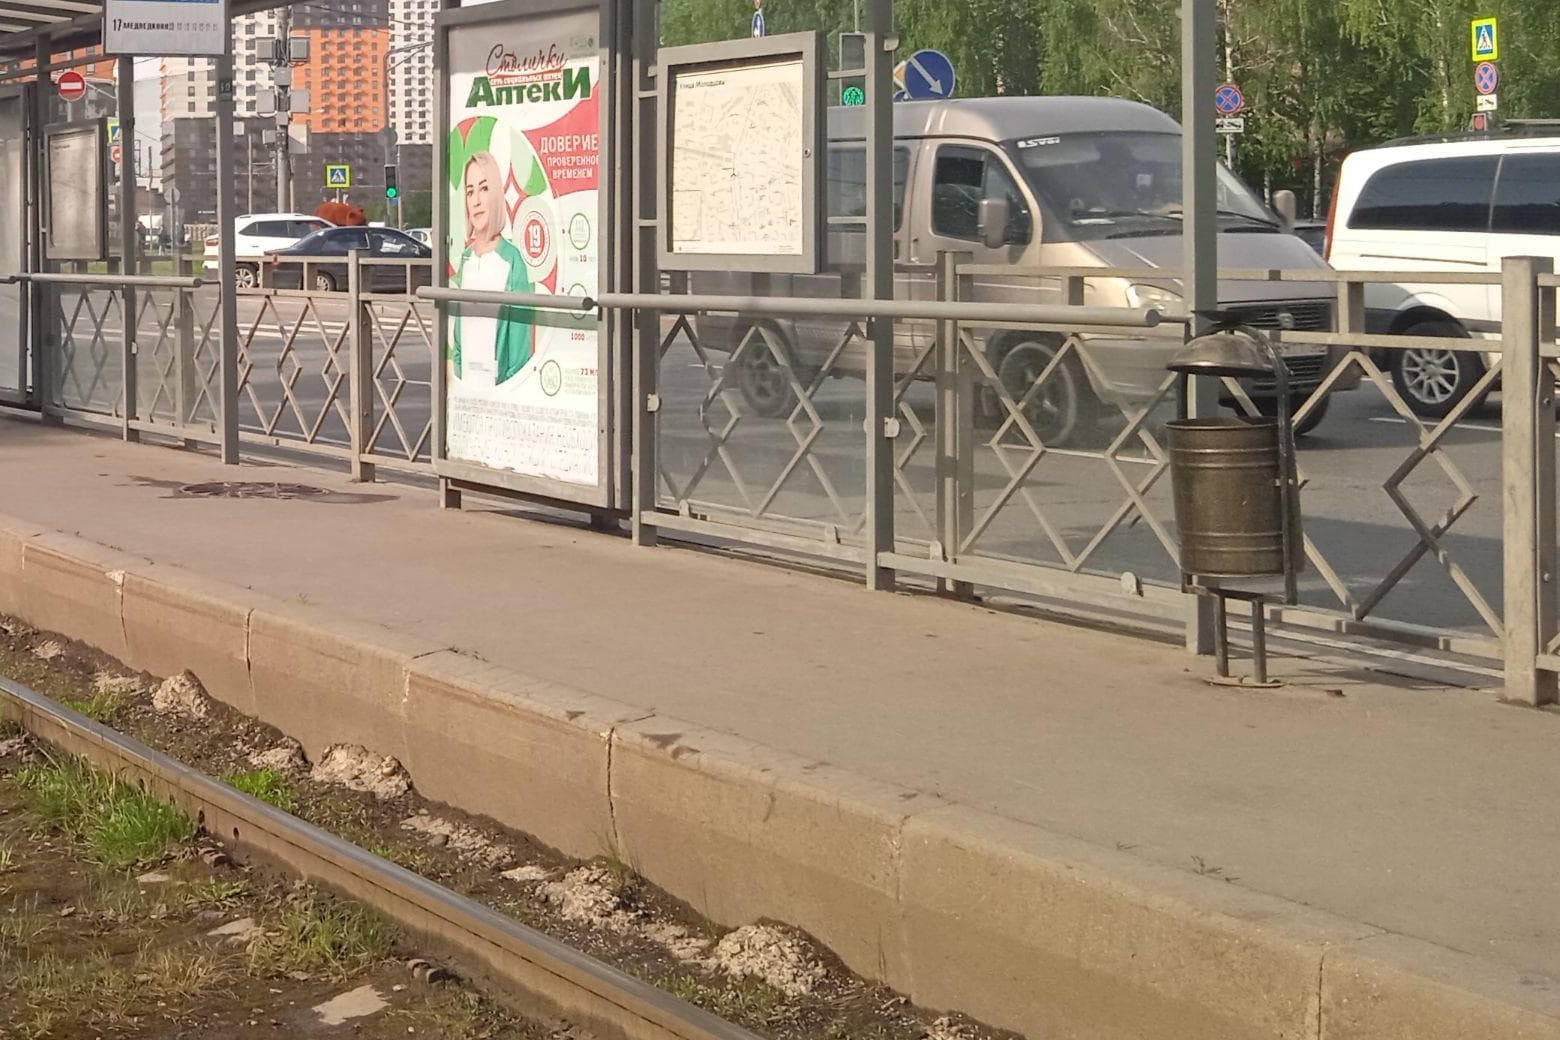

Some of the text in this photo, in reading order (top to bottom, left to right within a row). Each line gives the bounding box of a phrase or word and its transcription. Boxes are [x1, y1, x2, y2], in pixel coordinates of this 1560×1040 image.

[113, 18, 122, 31] 17
[486, 43, 568, 75] Столички
[540, 134, 598, 155] ДОВЕРИЕ
[552, 168, 593, 179] ВРЕМЕНЕМ
[529, 224, 541, 247] 19
